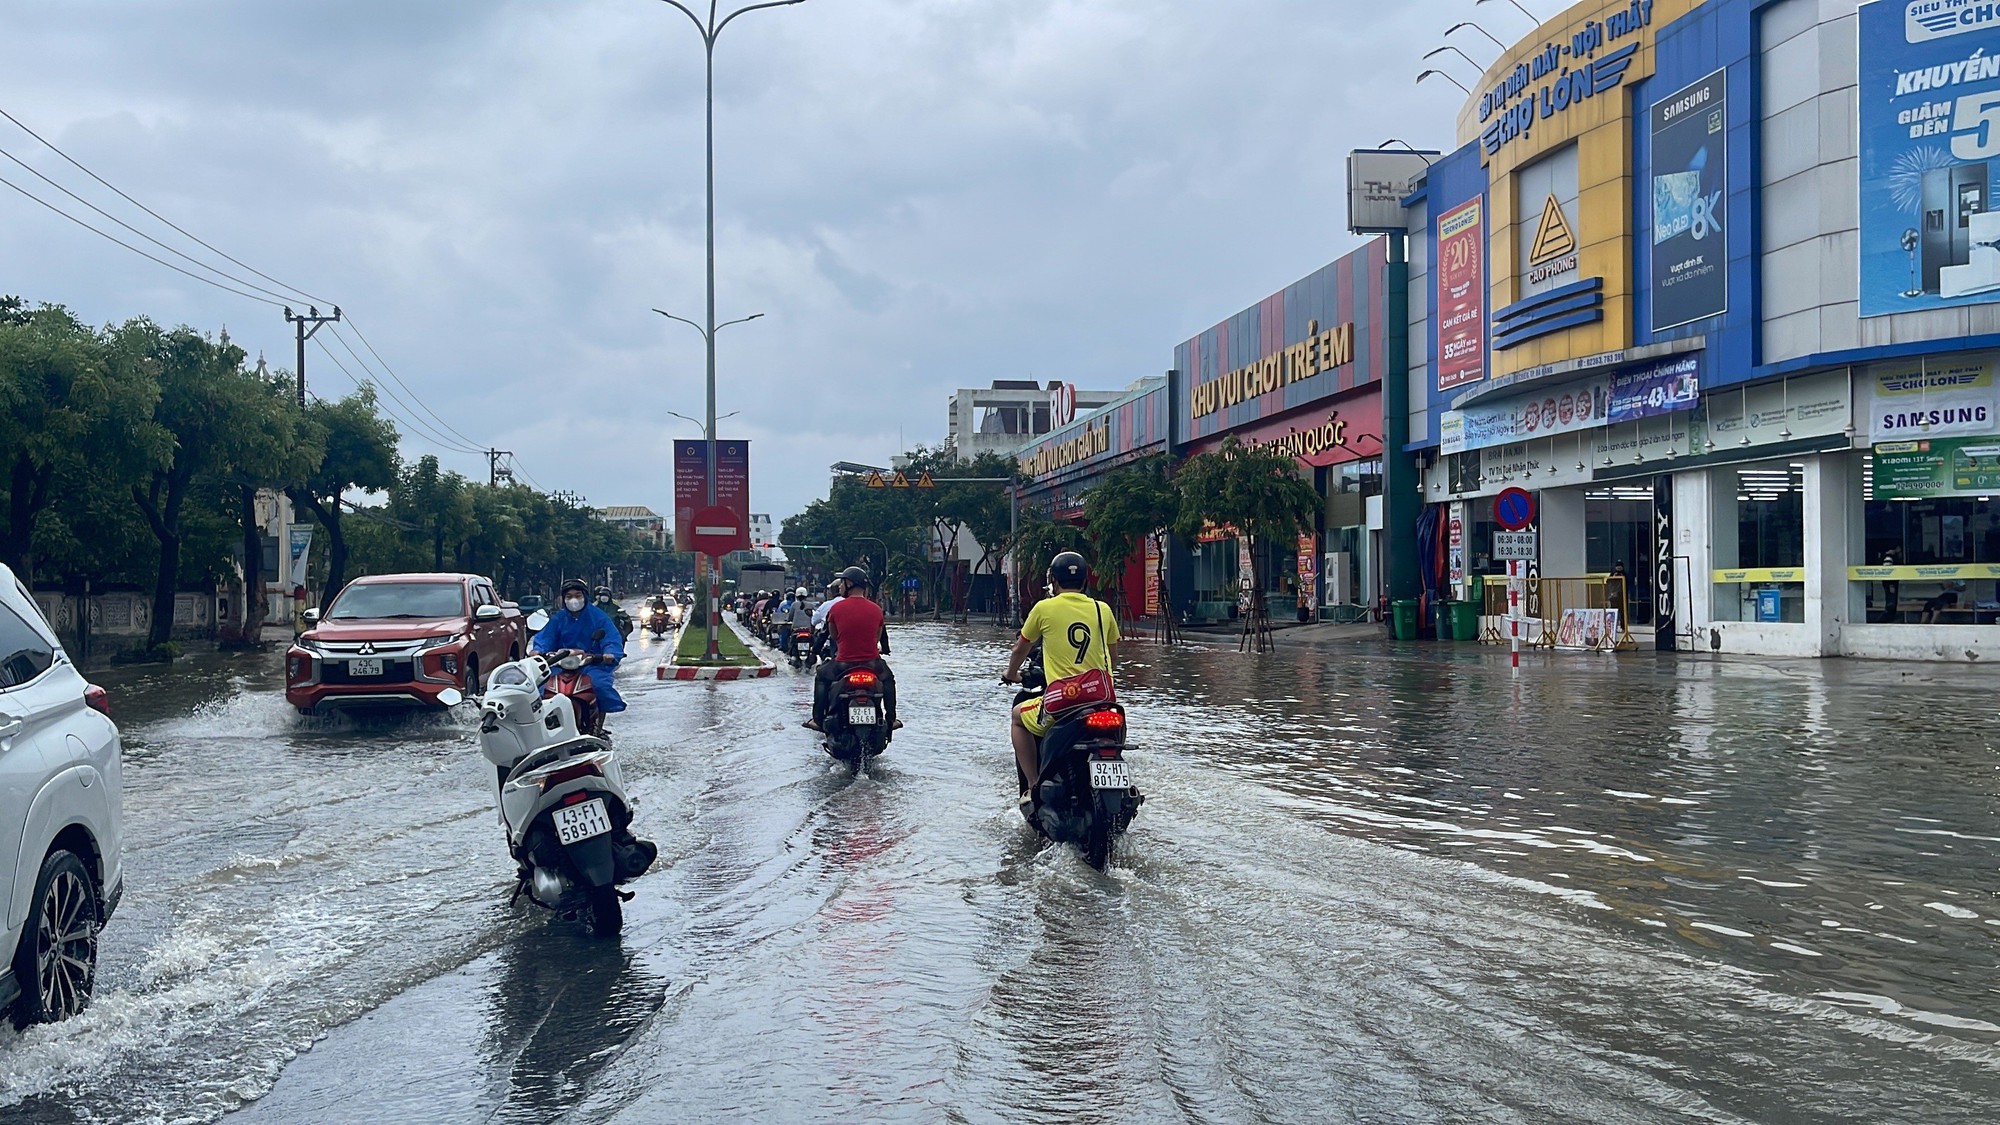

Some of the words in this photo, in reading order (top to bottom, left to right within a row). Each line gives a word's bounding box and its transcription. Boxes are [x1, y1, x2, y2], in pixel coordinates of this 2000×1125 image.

[1959, 3, 2000, 25] CH
[1492, 81, 1506, 110] THỊ
[1506, 63, 1530, 98] ĐIỆN
[1532, 42, 1561, 81] MÁY
[1572, 21, 1603, 59] NỘI
[1605, 0, 1653, 42] THẤT
[1895, 47, 2000, 97] KHUYẾN
[1499, 93, 1535, 145] CHỢ
[1541, 63, 1594, 120] LỚN
[1663, 86, 1710, 121] SAMSUNG
[1898, 101, 1952, 125] GIẢM
[1909, 117, 1949, 139] ĐẾN
[1655, 217, 1672, 240] Neo
[1672, 214, 1689, 233] QLED
[1690, 189, 1722, 241] 8K
[1450, 237, 1469, 273] 20
[1528, 266, 1546, 284] CAO
[1545, 256, 1577, 277] PHONG
[1692, 264, 1714, 279] nhiệm
[1444, 342, 1454, 360] 35
[1191, 380, 1218, 419] KHU
[1218, 368, 1243, 409] VUI
[1244, 351, 1285, 399] CHƠI
[1285, 319, 1319, 384] TRẺ
[1320, 322, 1353, 371] EM
[1633, 370, 1653, 383] THOẠI
[1653, 362, 1675, 378] CHÍNH
[1675, 359, 1697, 373] HÃNG
[1050, 383, 1077, 431] RIO
[1883, 406, 1986, 429] SAMSUNG
[1033, 446, 1047, 476] TÂM
[1047, 446, 1059, 472] VUI
[1077, 421, 1095, 460] GIẢI
[1094, 415, 1110, 453] TRÍ
[1305, 411, 1347, 455] QUỐC
[1489, 466, 1496, 476] TV
[1497, 536, 1512, 544] 06:30
[1517, 536, 1533, 544] 08:00
[1497, 547, 1512, 556] 16:30
[1517, 547, 1533, 556] 18:30
[1657, 507, 1671, 617] SONY
[1068, 622, 1092, 665] 9
[852, 708, 872, 716] 92-E1
[1094, 775, 1129, 787] 801.75
[1096, 763, 1124, 775] 92-H1
[562, 803, 598, 826] 43-F1
[561, 816, 606, 842] 589.11
